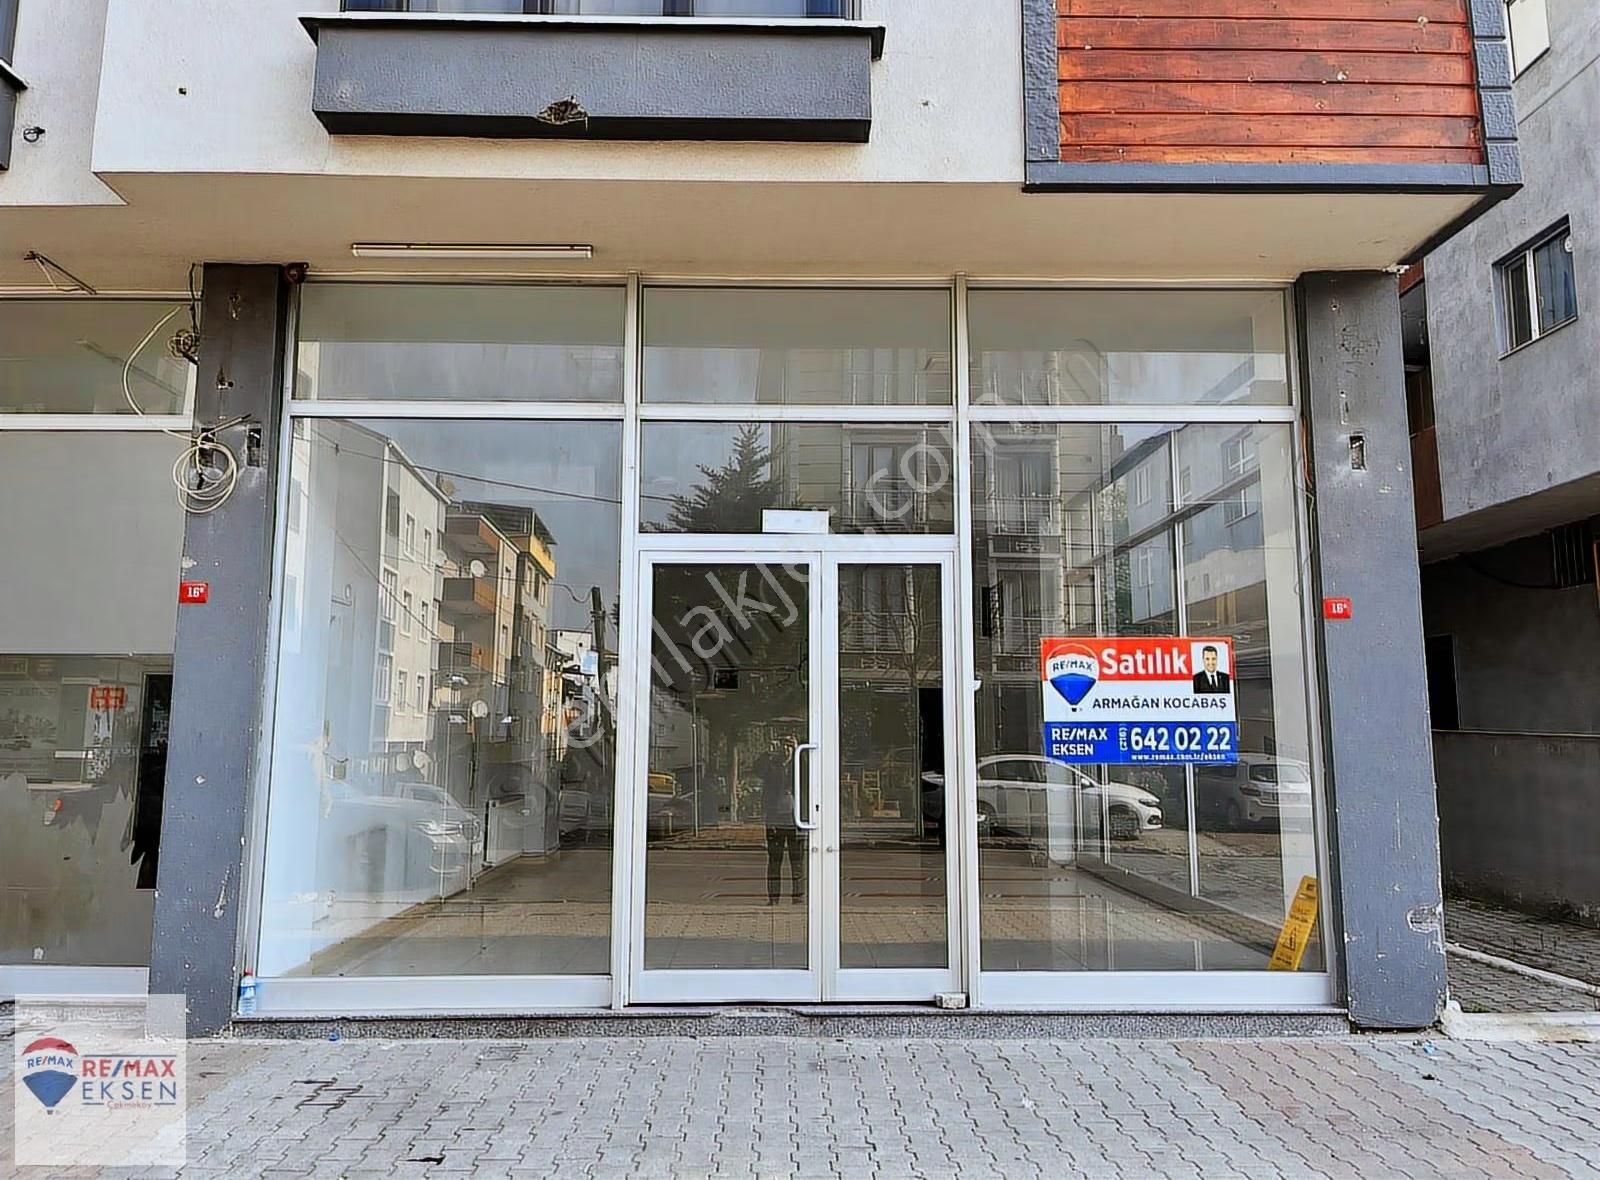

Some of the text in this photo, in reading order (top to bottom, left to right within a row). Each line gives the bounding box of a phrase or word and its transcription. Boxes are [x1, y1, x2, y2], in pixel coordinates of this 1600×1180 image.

[1052, 660, 1093, 673] RE/MAX
[1102, 647, 1189, 675] Satılık
[1092, 695, 1227, 710] ARMAĞAN KOCABAŞ
[1051, 727, 1108, 741] RE/MAX
[1130, 726, 1170, 751] 642
[1174, 726, 1202, 751] 02
[1206, 726, 1232, 751] 22
[1052, 743, 1094, 756] EKSEN
